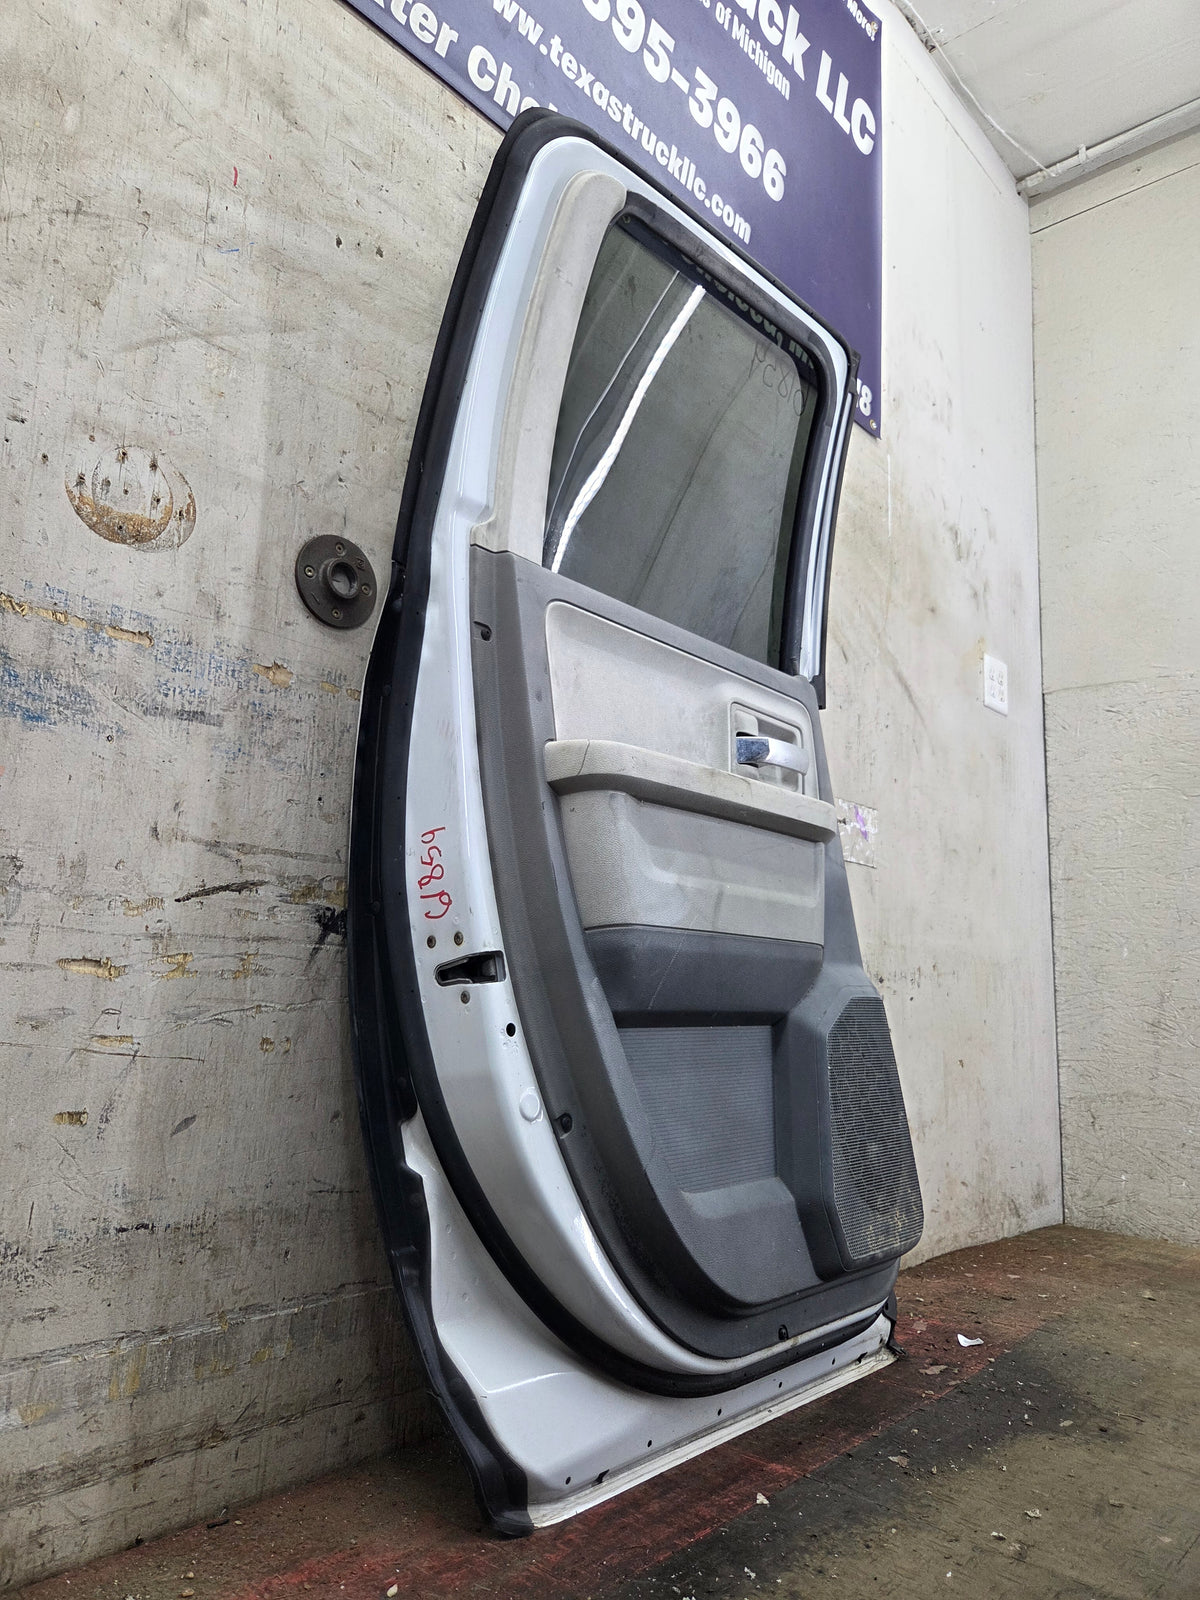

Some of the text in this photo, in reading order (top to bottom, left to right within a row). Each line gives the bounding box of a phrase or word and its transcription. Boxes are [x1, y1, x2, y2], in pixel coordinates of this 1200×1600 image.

[374, 0, 459, 58] ter
[715, 2, 791, 101] Of Michigan
[815, 50, 876, 156] LLC
